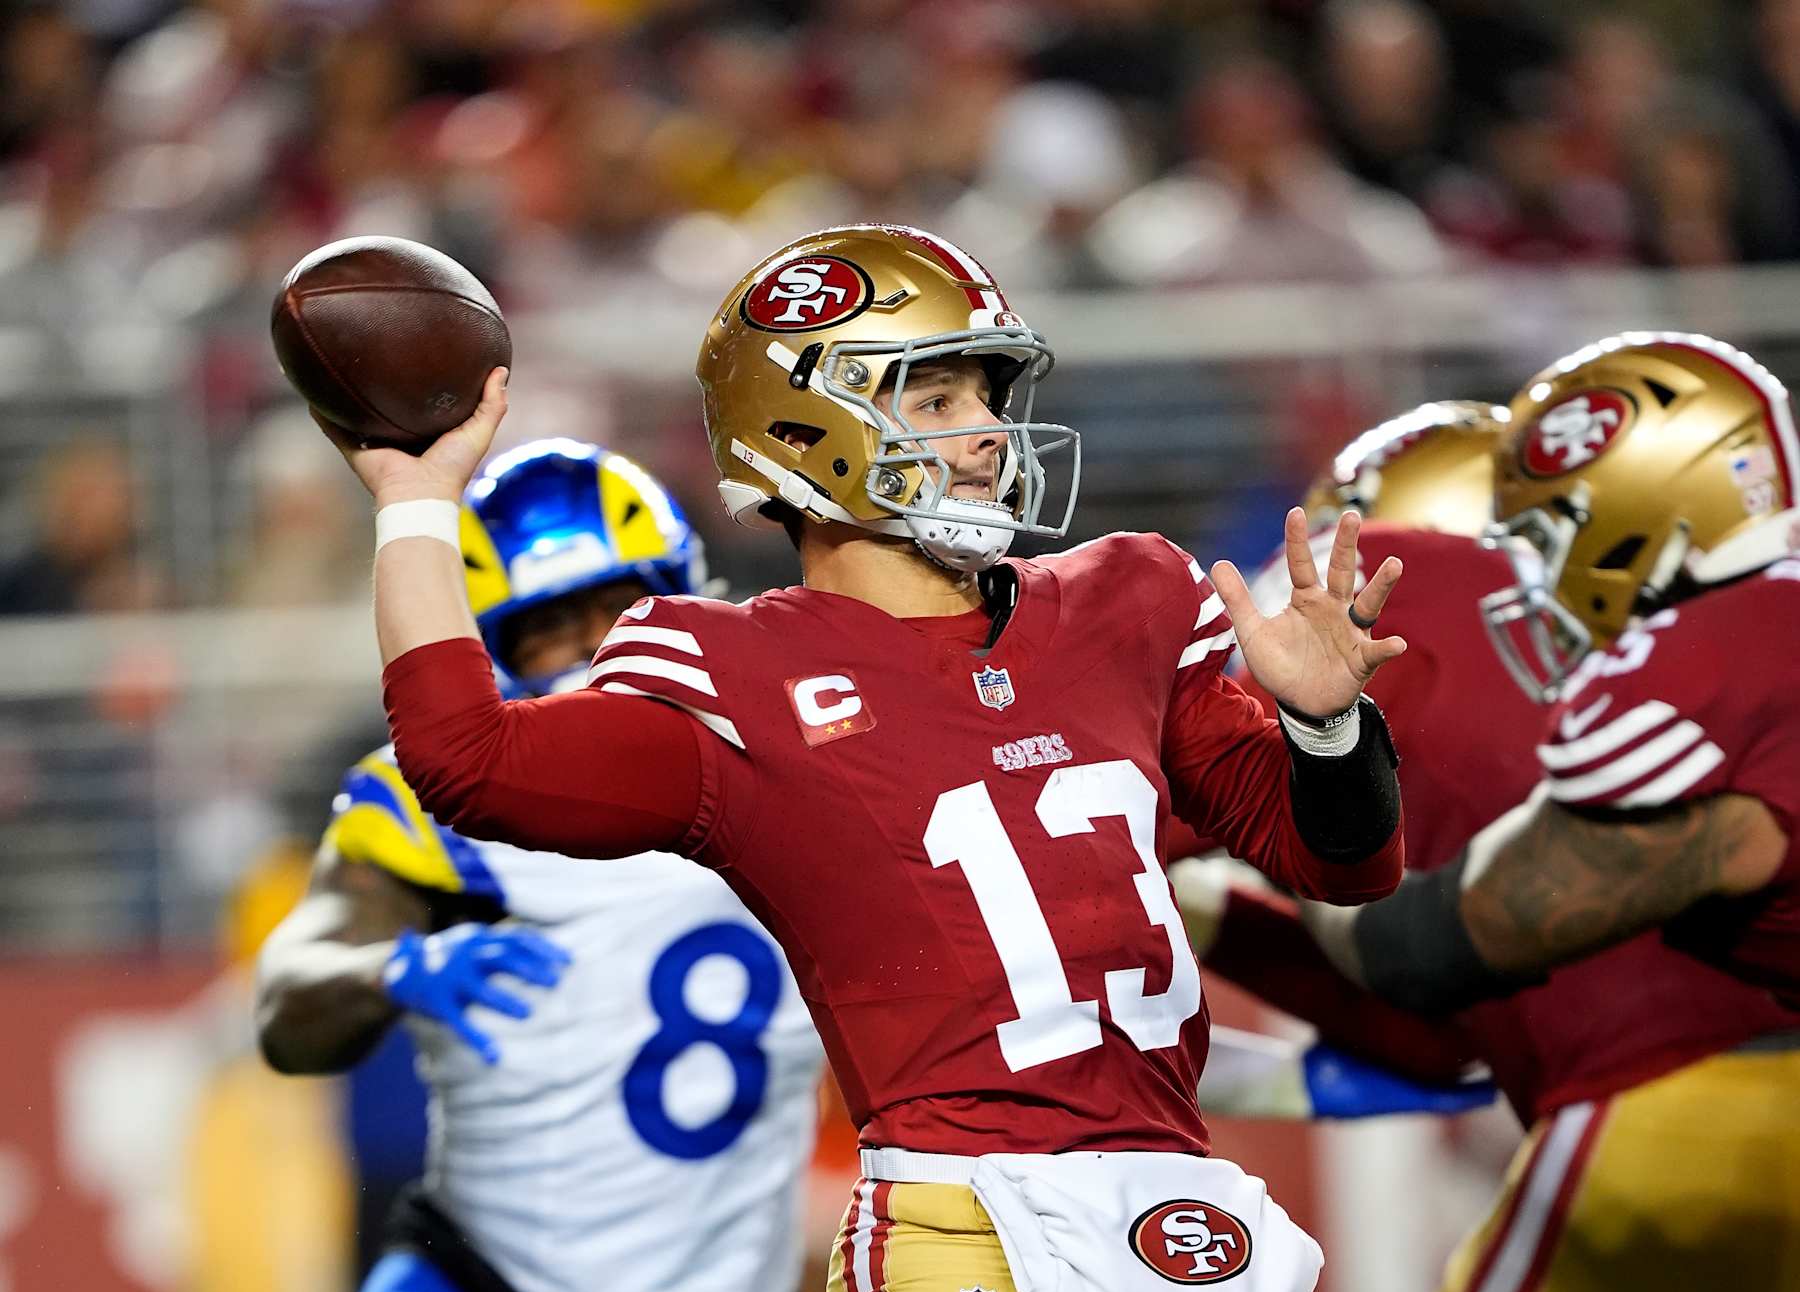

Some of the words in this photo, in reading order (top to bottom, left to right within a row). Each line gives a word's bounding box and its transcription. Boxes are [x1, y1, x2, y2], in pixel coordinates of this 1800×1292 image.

[768, 263, 847, 323] SF
[743, 449, 754, 464] 13
[793, 675, 863, 727] C
[982, 684, 1009, 703] NFL
[991, 732, 1073, 772] 49ERS
[922, 758, 1201, 1074] 13
[621, 920, 783, 1161] 8
[1160, 1208, 1237, 1276] SF
